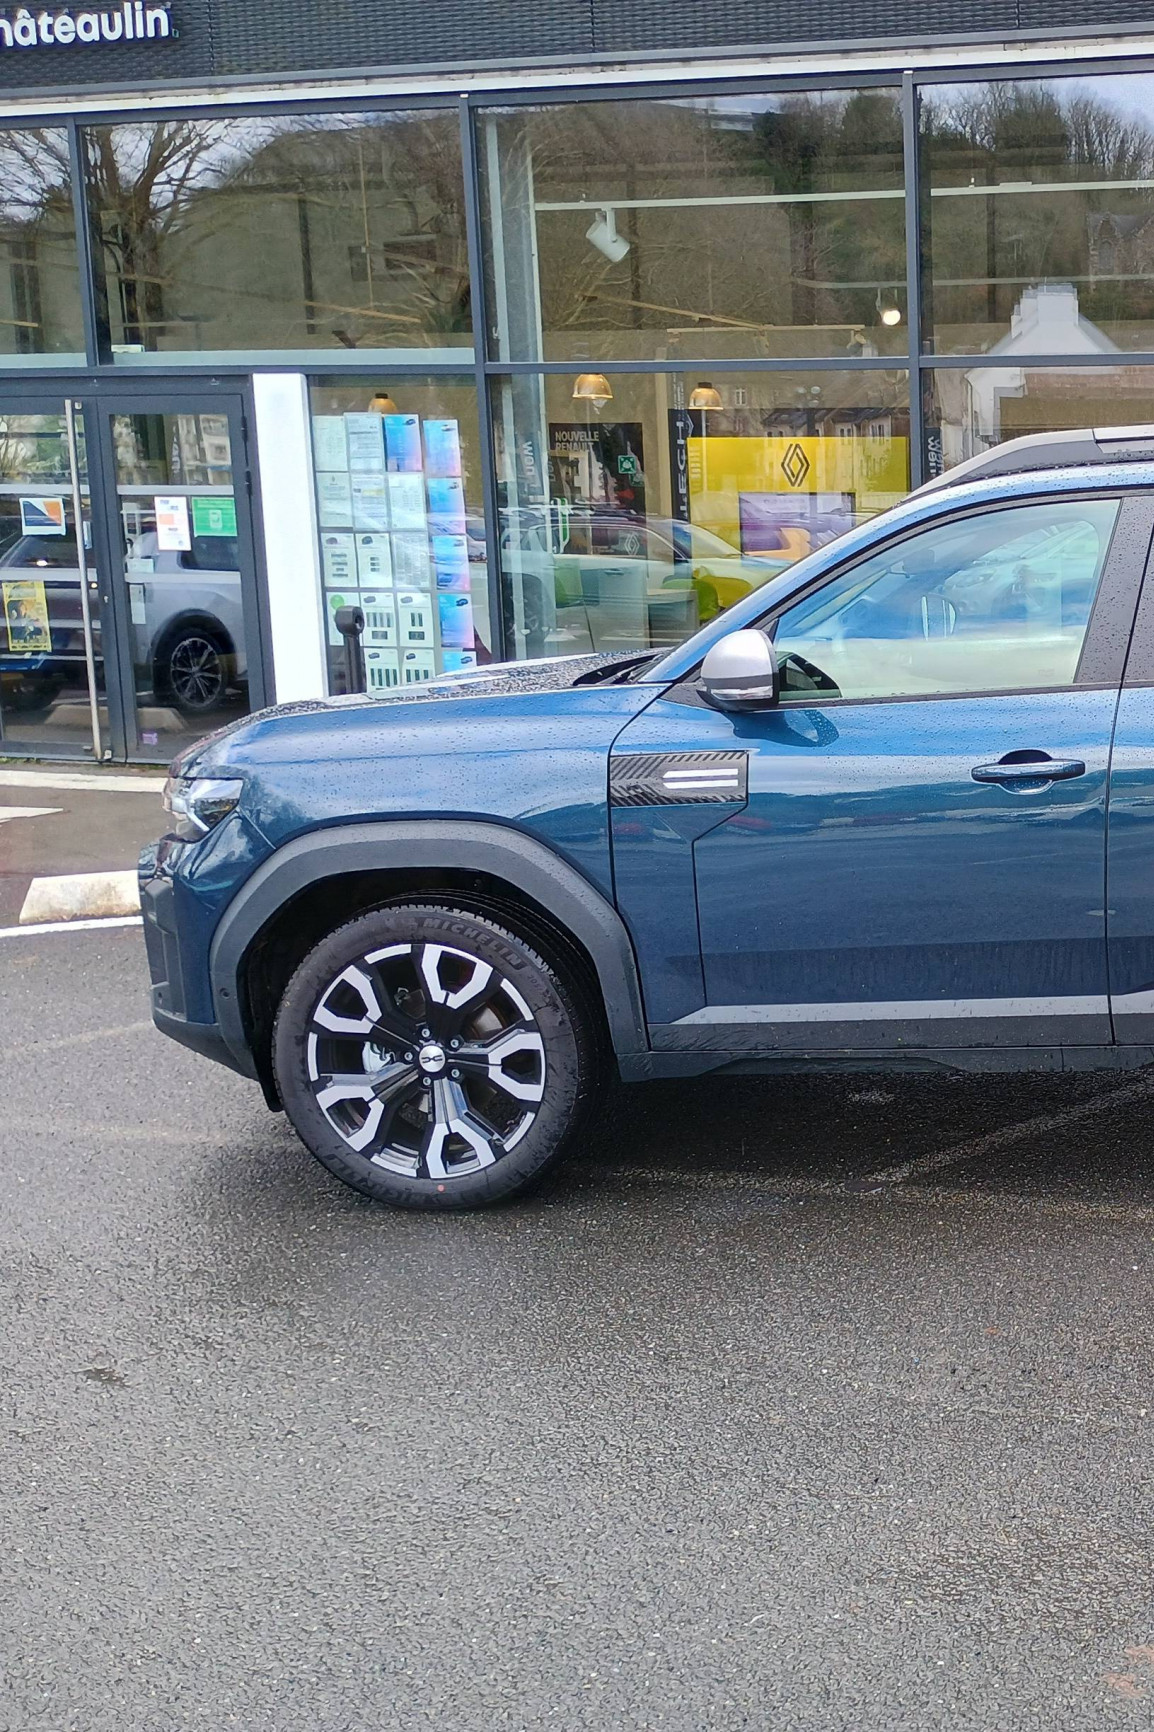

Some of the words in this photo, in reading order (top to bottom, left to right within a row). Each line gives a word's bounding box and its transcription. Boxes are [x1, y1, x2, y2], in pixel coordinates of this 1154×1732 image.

[555, 431, 600, 441] NOUVELLE
[555, 442, 594, 452] RENAULT
[423, 917, 523, 967] MICHELIN
